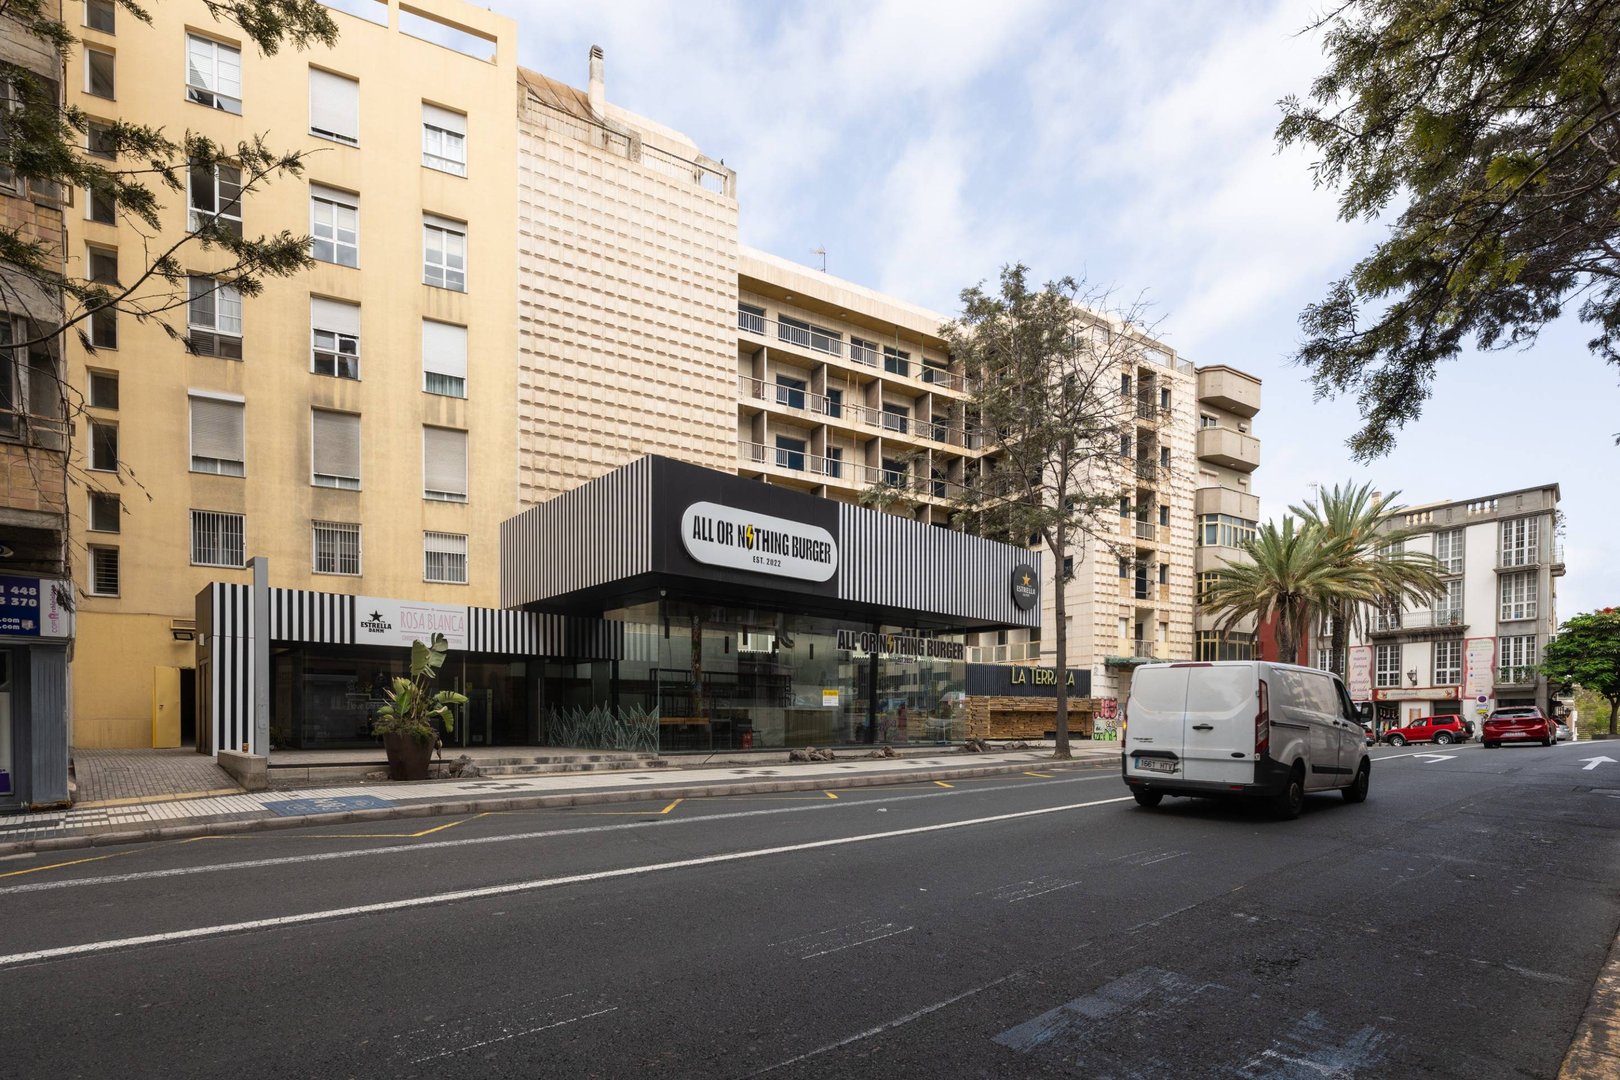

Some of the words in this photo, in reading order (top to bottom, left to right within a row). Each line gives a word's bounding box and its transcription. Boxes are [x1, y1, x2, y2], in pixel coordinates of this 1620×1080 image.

[692, 515, 714, 542] ALL
[717, 519, 733, 546] OR
[737, 523, 789, 557] NOTHING
[791, 535, 831, 564] BURGER
[752, 555, 766, 565] EST.
[766, 558, 781, 567] 2022
[10, 586, 37, 596] 448
[11, 597, 37, 607] 370
[360, 621, 392, 630] ESTRELLA
[400, 610, 425, 630] ROSA
[428, 613, 465, 632] BLANCA
[837, 630, 857, 651] ALL
[860, 632, 876, 653] OR
[878, 632, 925, 656] NOTHING
[927, 638, 964, 660] BURGER
[1011, 666, 1026, 684] LA
[1030, 666, 1075, 686] TERRA
